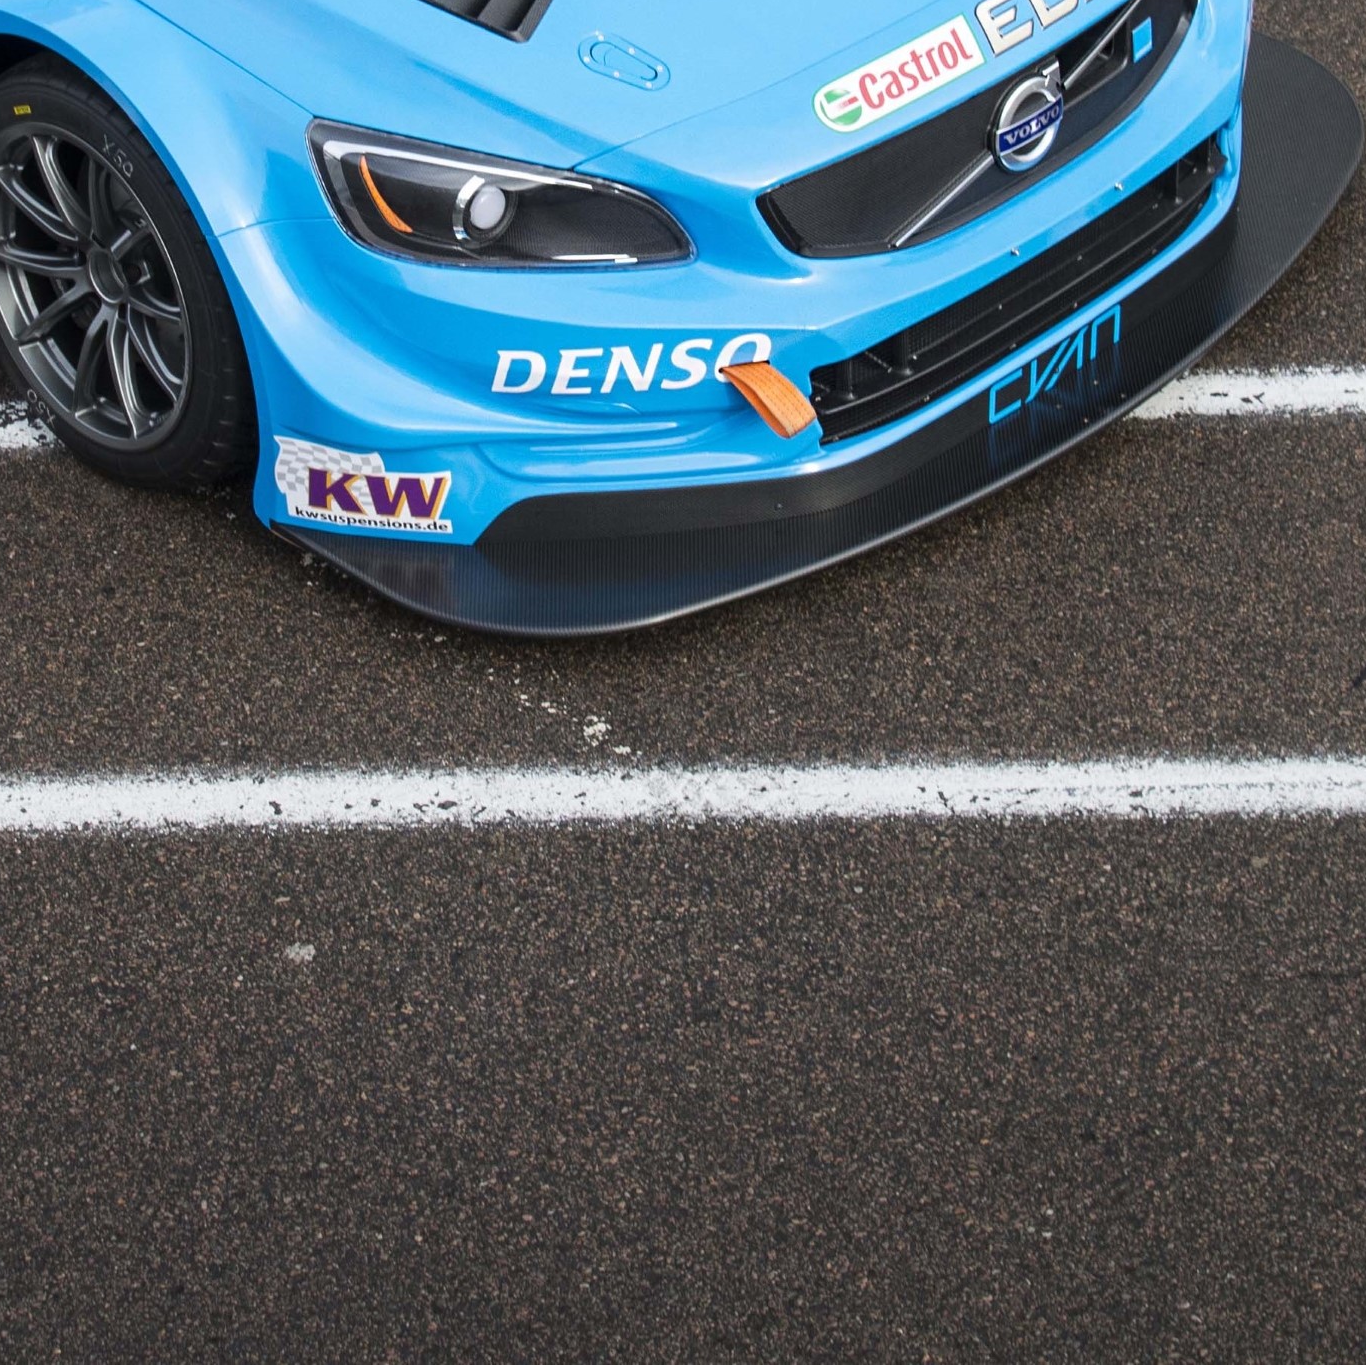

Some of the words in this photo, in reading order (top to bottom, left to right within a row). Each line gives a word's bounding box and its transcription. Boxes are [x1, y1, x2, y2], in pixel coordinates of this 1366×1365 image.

[857, 28, 973, 111] Castrol
[1003, 102, 1061, 146] VOLVO
[491, 333, 772, 395] DENSO
[988, 303, 1122, 425] CYAN
[295, 506, 449, 532] kwsuspensions.de
[307, 467, 448, 521] KW
